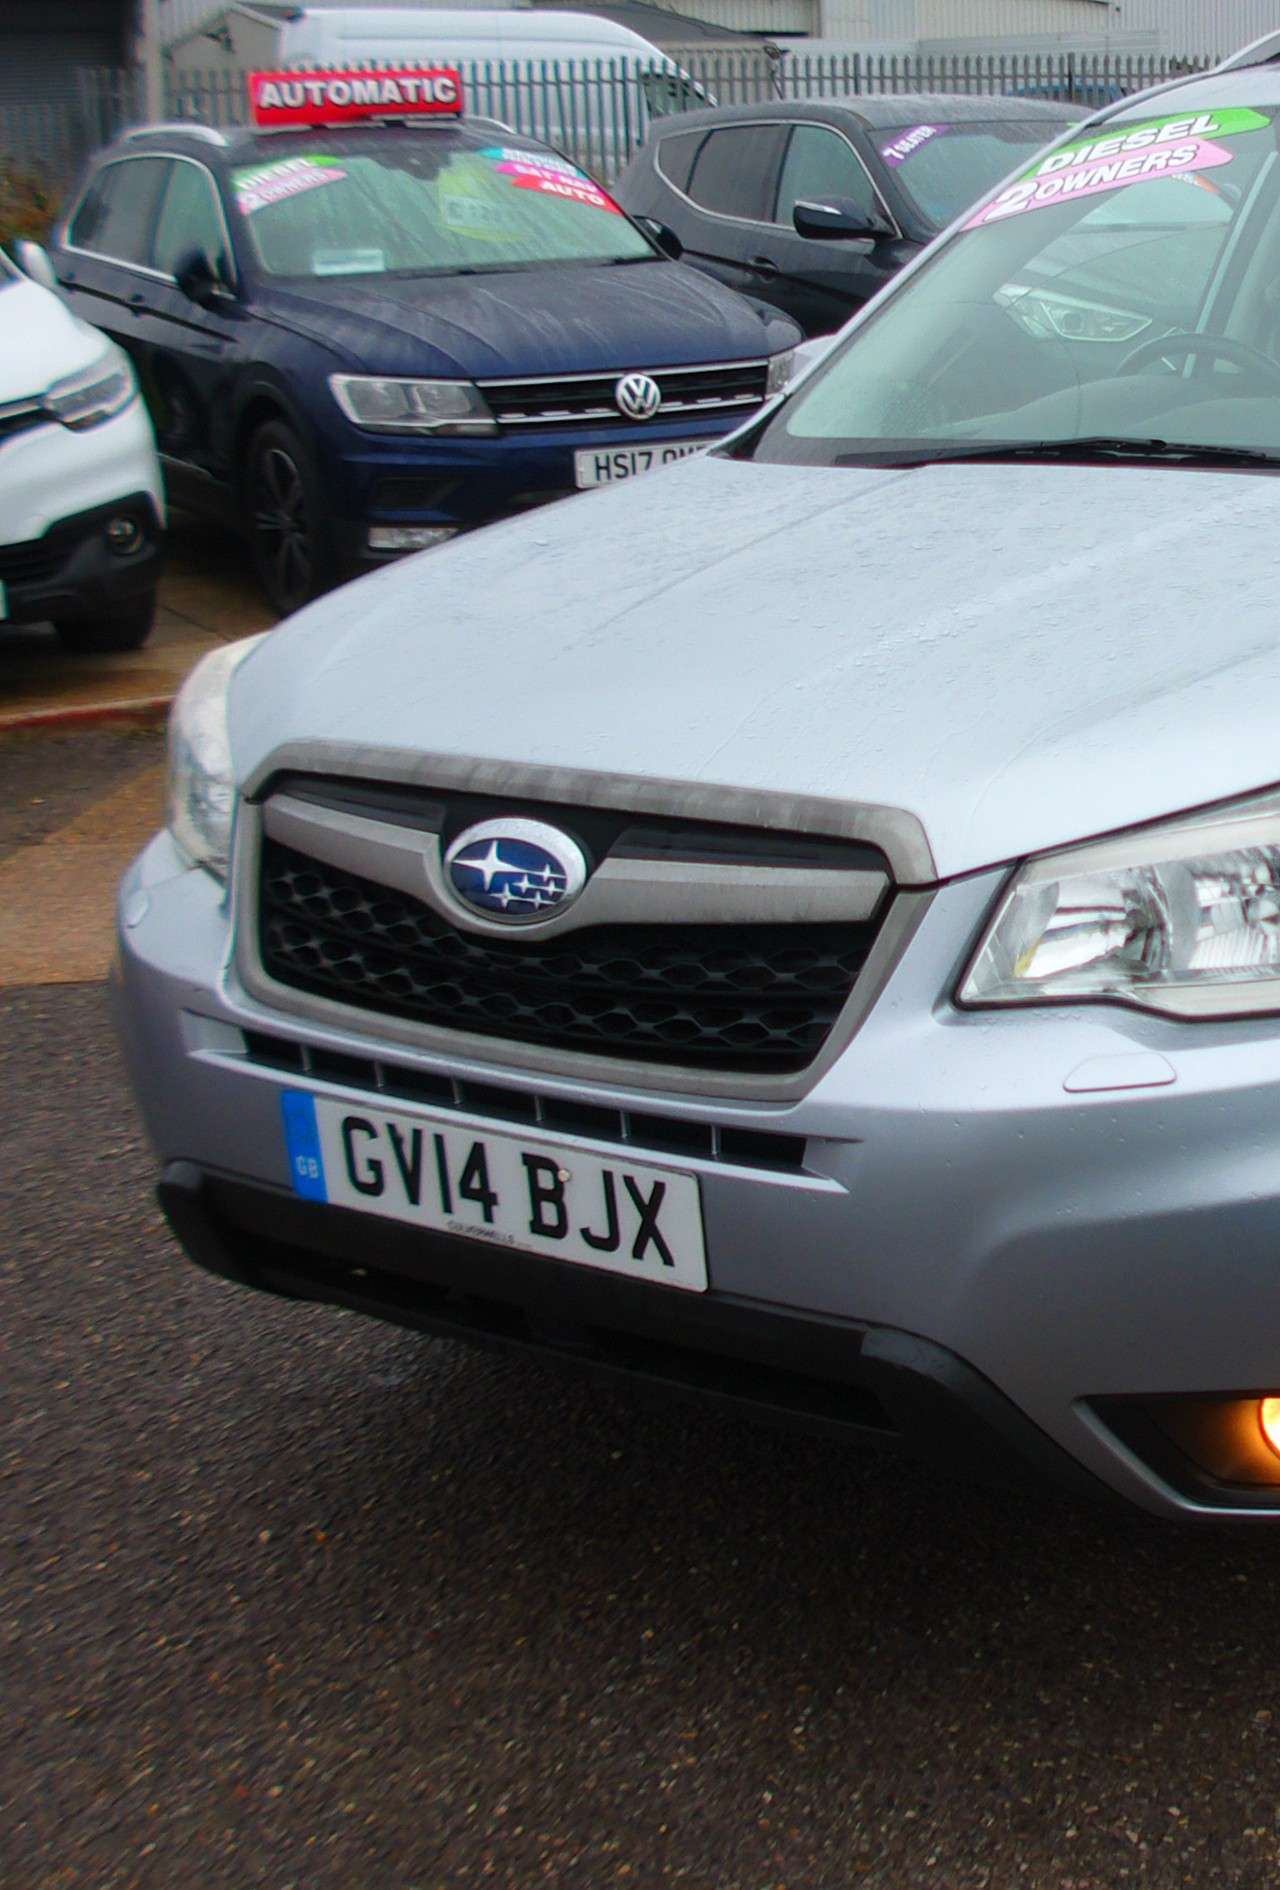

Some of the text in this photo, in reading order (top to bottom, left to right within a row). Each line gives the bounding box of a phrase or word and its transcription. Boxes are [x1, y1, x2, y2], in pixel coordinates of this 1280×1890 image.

[259, 77, 457, 108] AUTOMATIC
[882, 147, 904, 160] 7
[1036, 114, 1220, 176] DIESEL
[540, 180, 606, 207] AUTO
[982, 144, 1199, 222] 2 OWNERS
[594, 451, 653, 482] HS17
[295, 1155, 319, 1180] GB
[342, 1115, 676, 1267] GV14 BJX
